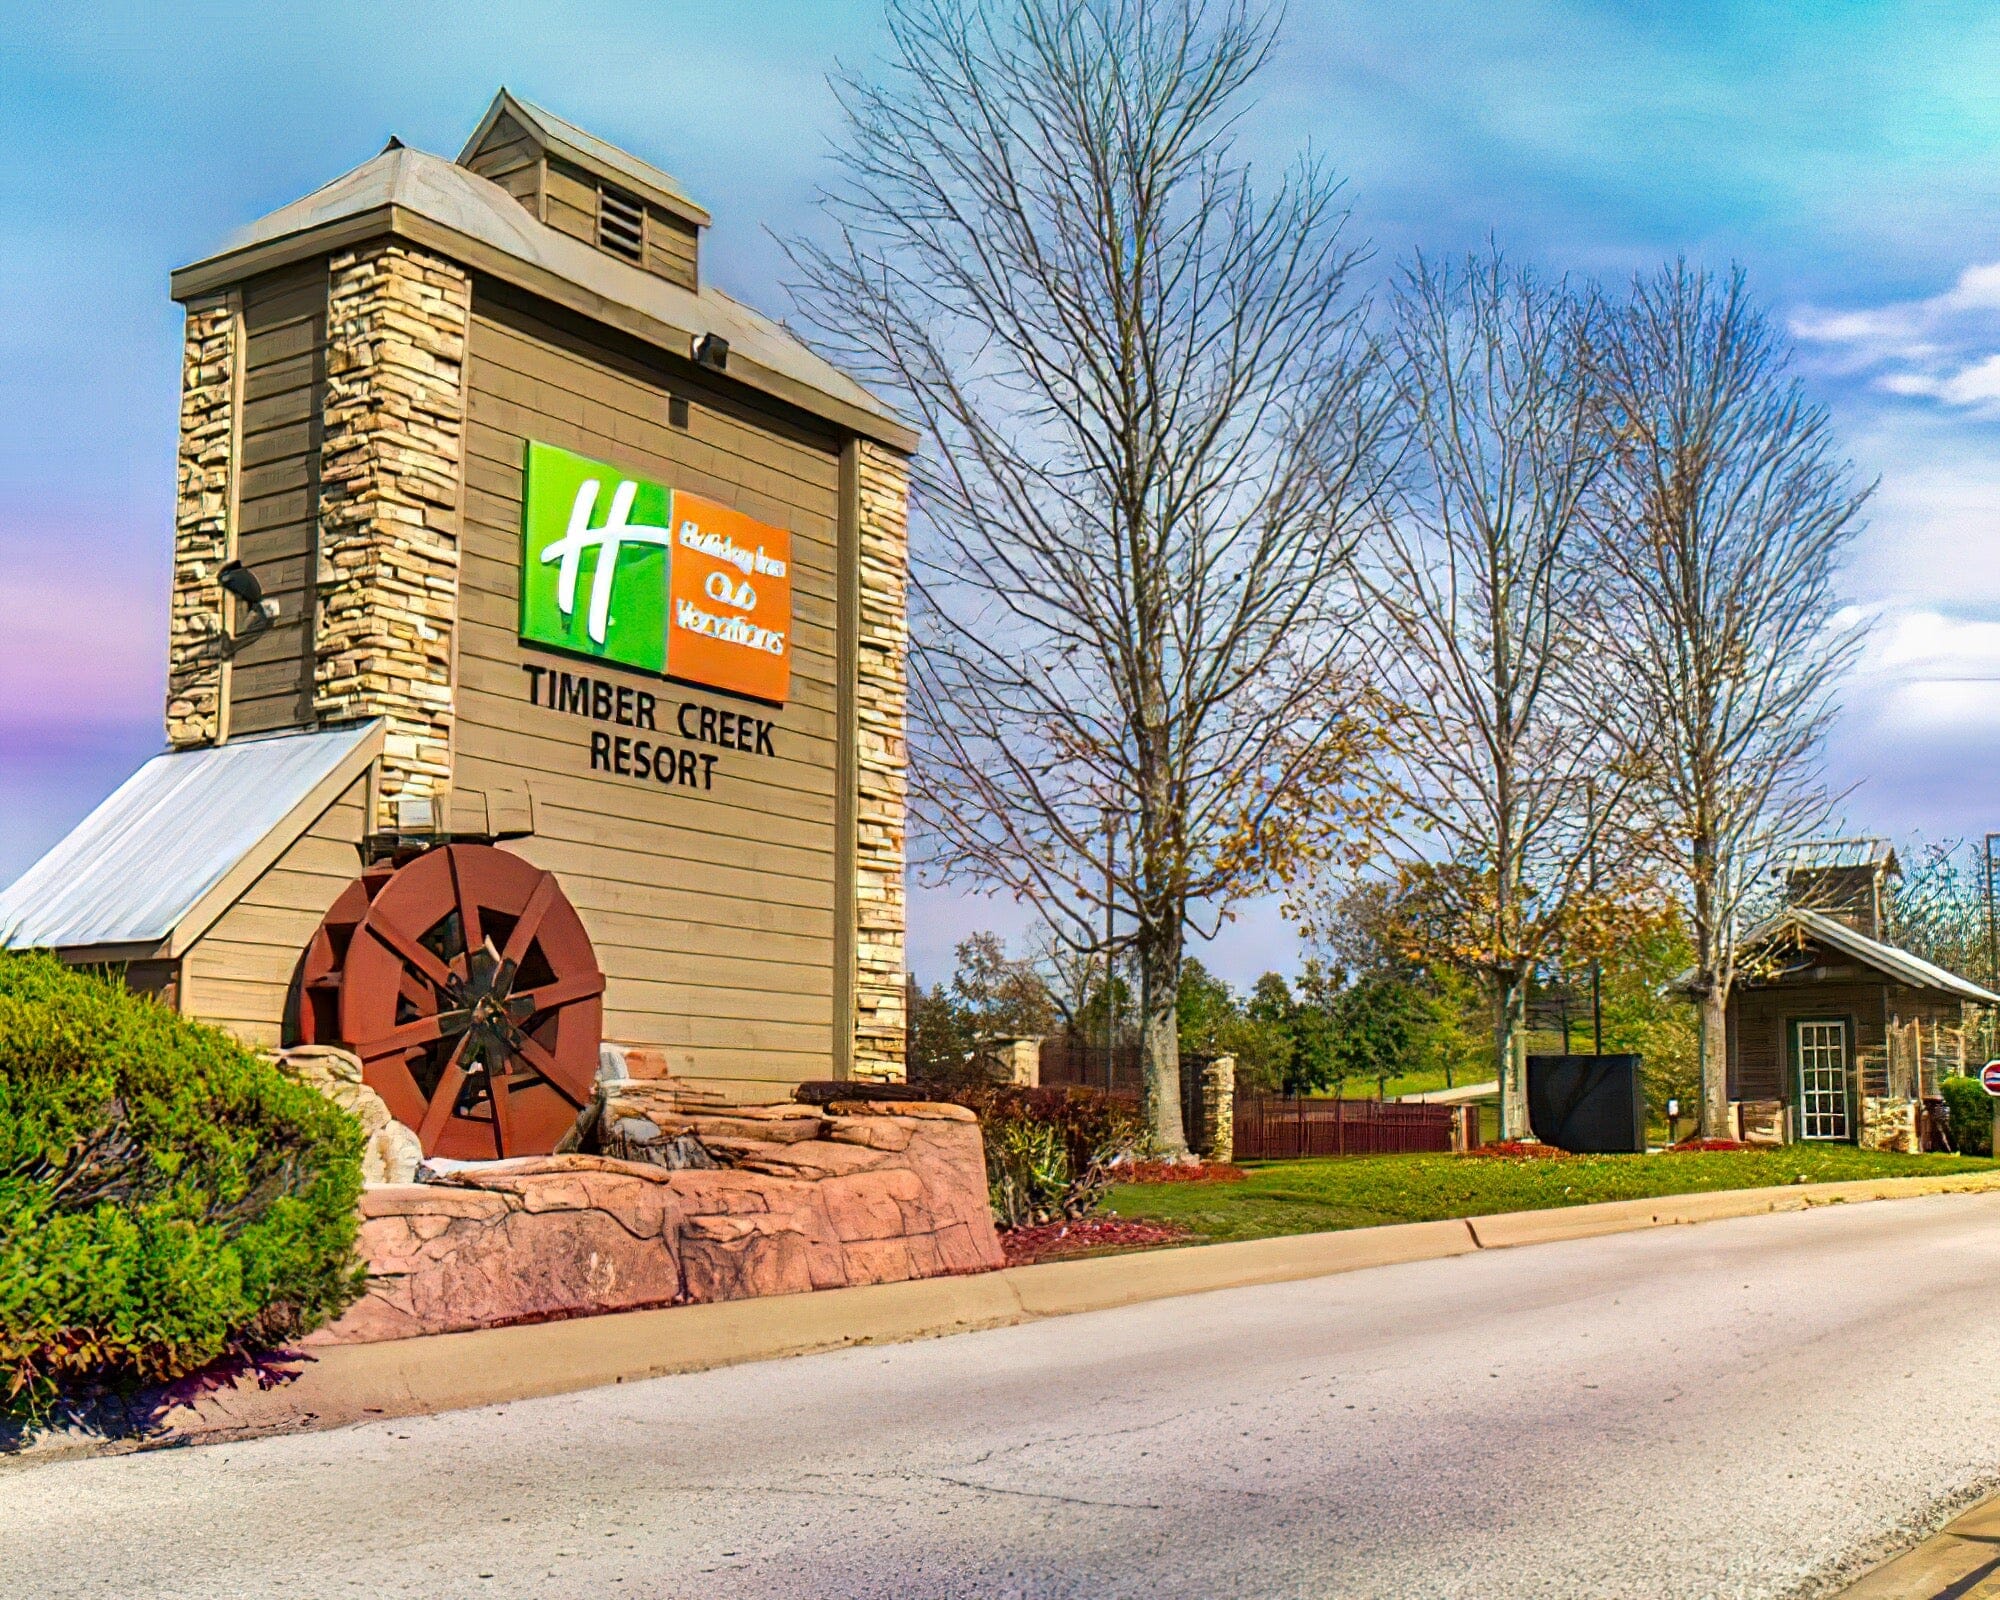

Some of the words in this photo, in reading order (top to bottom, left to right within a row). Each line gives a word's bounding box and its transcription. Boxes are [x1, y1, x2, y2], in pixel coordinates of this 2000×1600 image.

[522, 664, 656, 731] TIMBER
[677, 702, 776, 757] CREEK
[590, 731, 719, 790] RESORT
